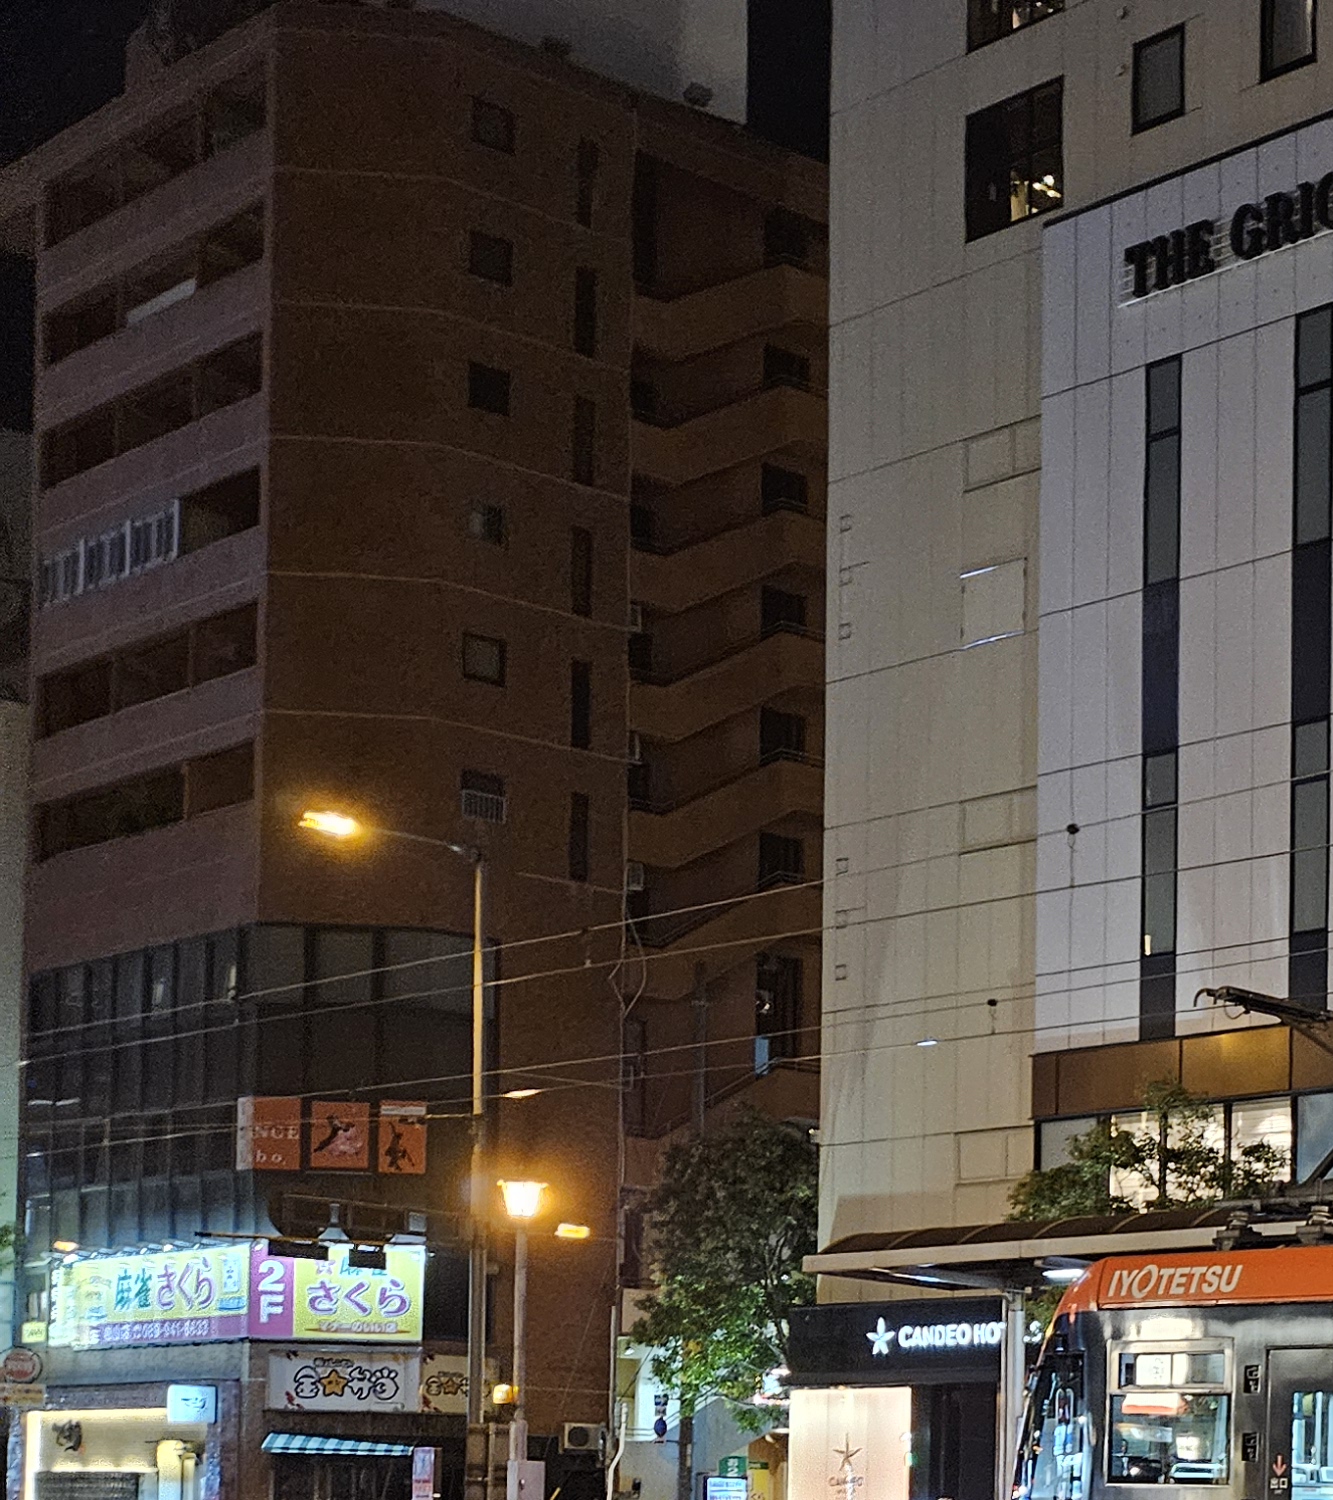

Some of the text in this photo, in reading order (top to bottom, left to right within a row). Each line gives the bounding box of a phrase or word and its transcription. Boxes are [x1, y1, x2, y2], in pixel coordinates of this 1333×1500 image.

[1124, 219, 1214, 297] THE
[258, 1259, 285, 1323] 2F
[306, 1279, 411, 1318] さくら
[1107, 1264, 1243, 1299] IYOTETSU
[898, 1323, 973, 1348] CANDEO
